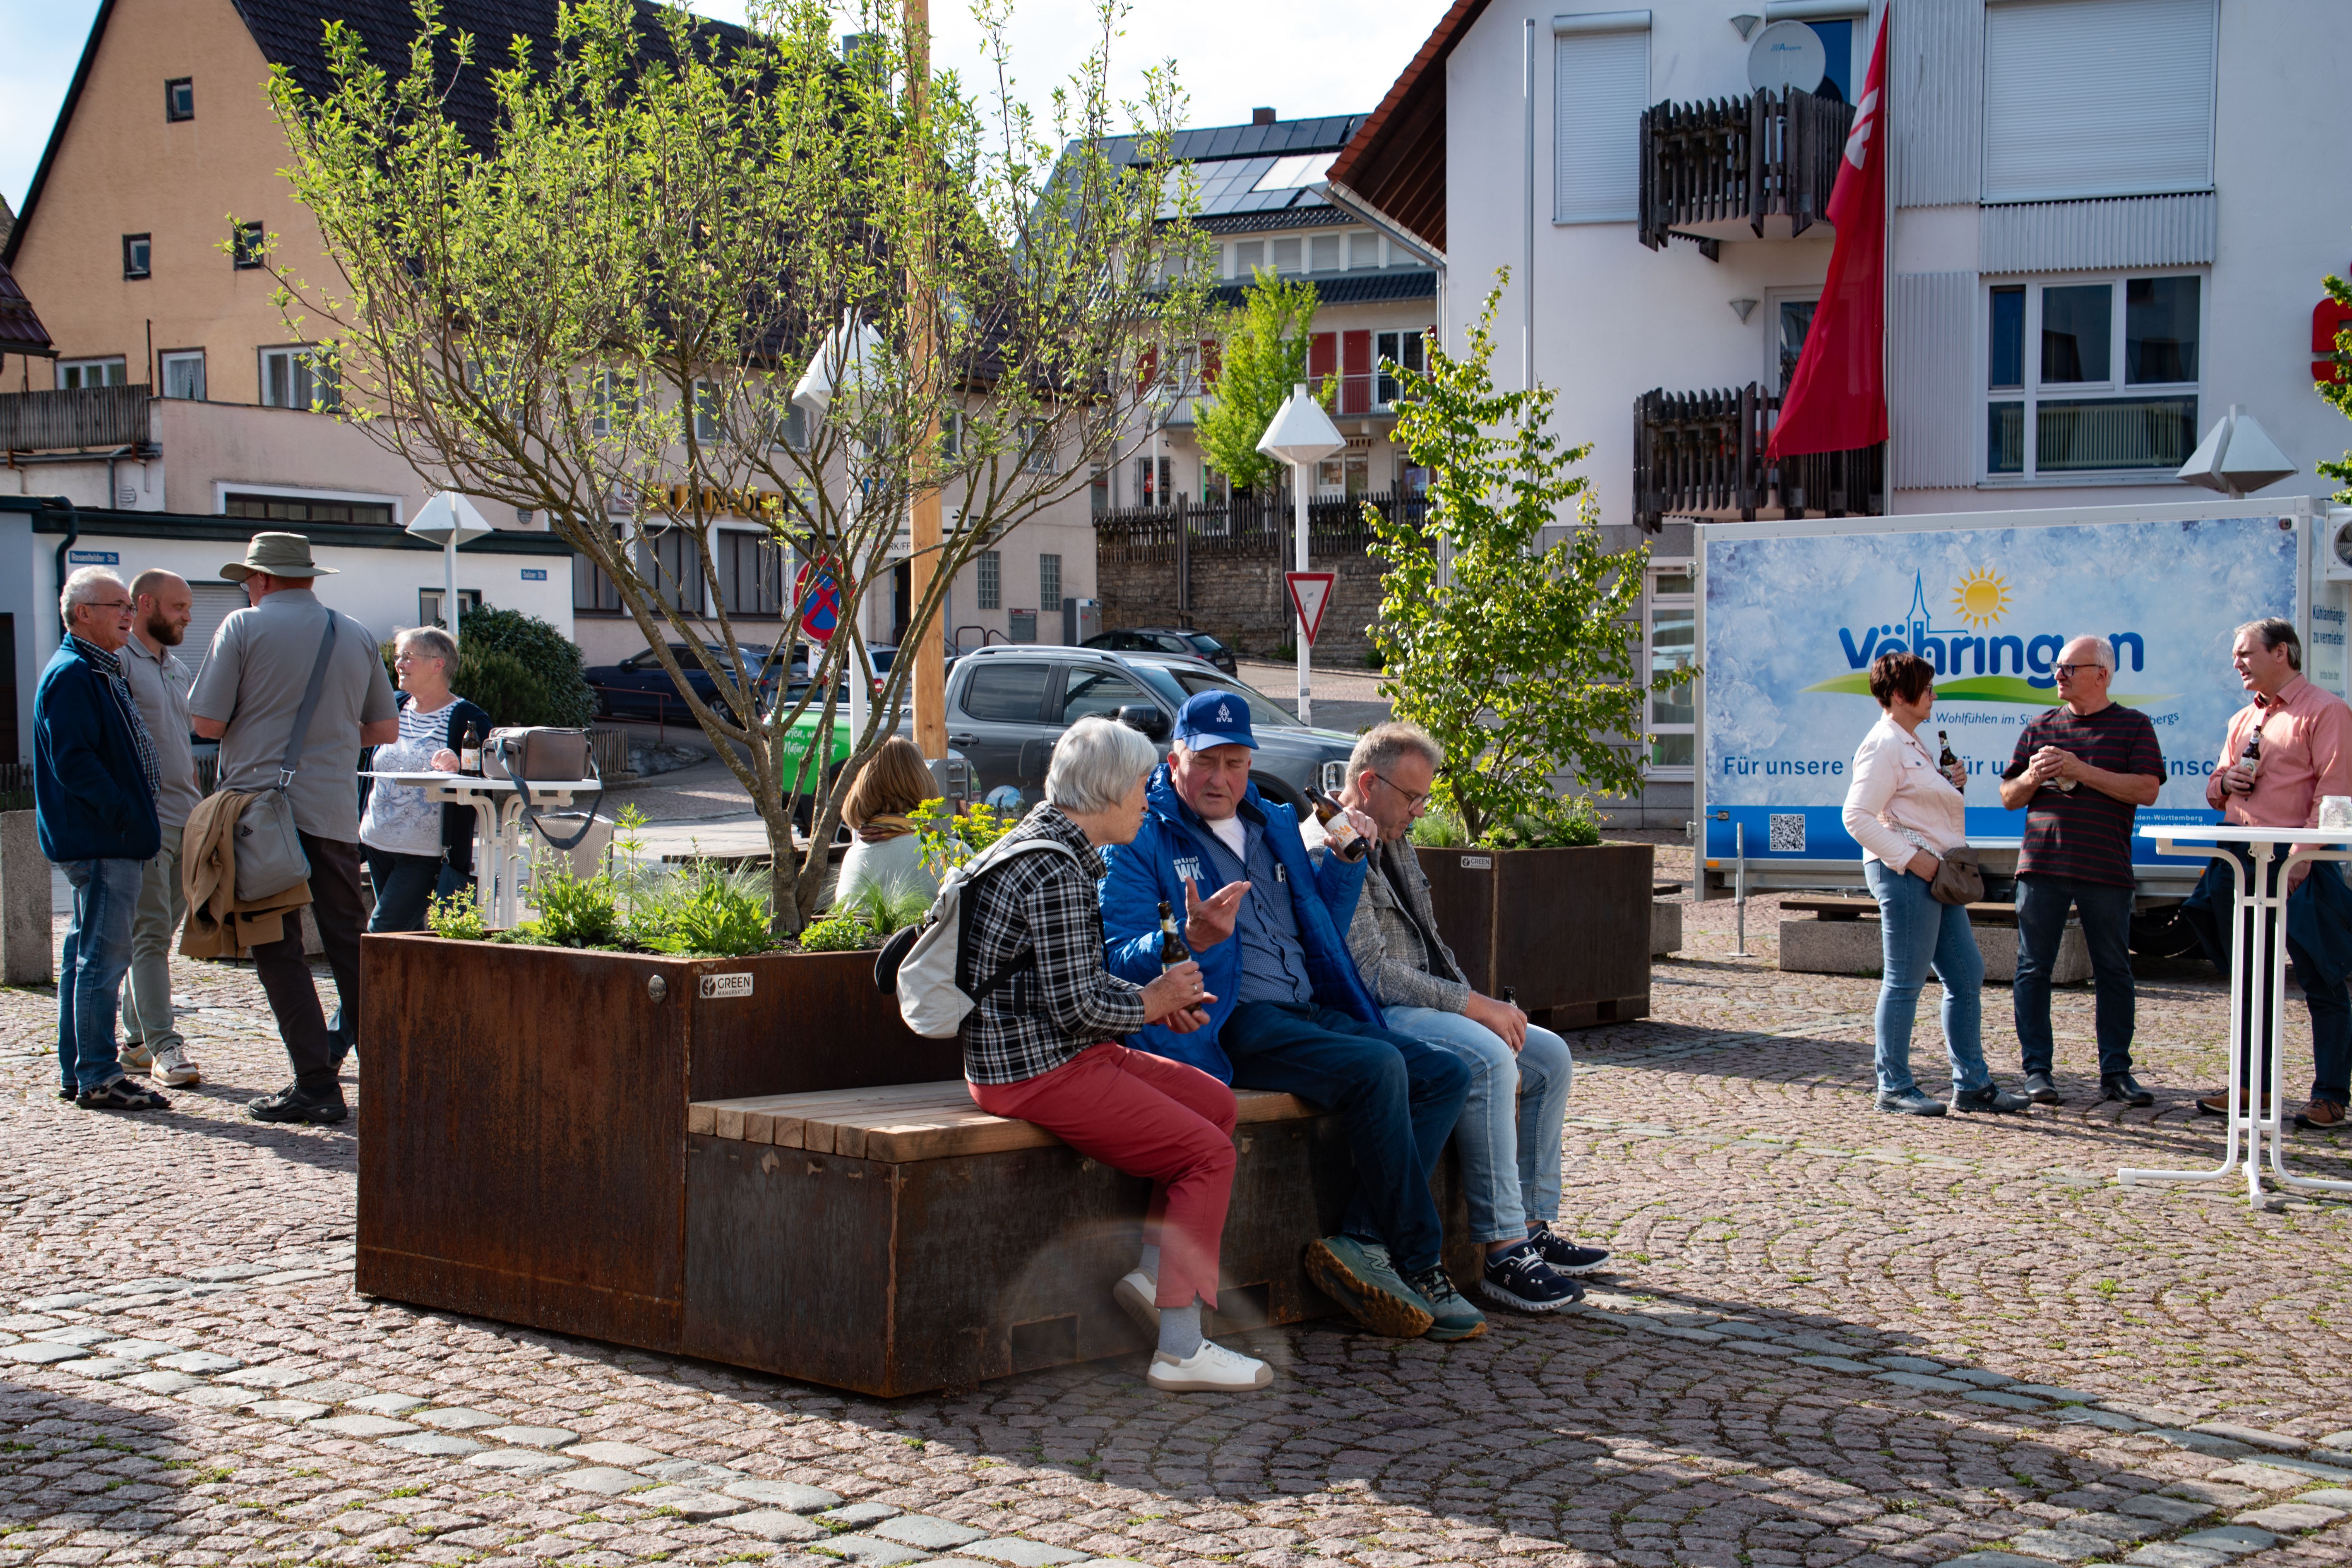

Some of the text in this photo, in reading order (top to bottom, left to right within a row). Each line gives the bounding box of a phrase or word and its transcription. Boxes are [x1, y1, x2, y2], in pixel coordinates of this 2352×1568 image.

[71, 552, 118, 563] Rosenfelder Str.
[2312, 604, 2347, 625] Kühlanhänger
[2313, 630, 2346, 646] zu vermieten!
[1838, 621, 2144, 689] Vöhringn
[1936, 712, 1997, 725] Wohlfühlen
[2149, 712, 2179, 725] bergs
[784, 741, 805, 756] Natur
[1724, 756, 1759, 775] Für
[1766, 759, 1844, 775] unsere
[1956, 756, 1984, 775] ür
[2163, 756, 2220, 776] insc
[1173, 855, 1199, 865] BUBI
[1175, 862, 1205, 883] WK
[718, 977, 750, 989] GREEN
